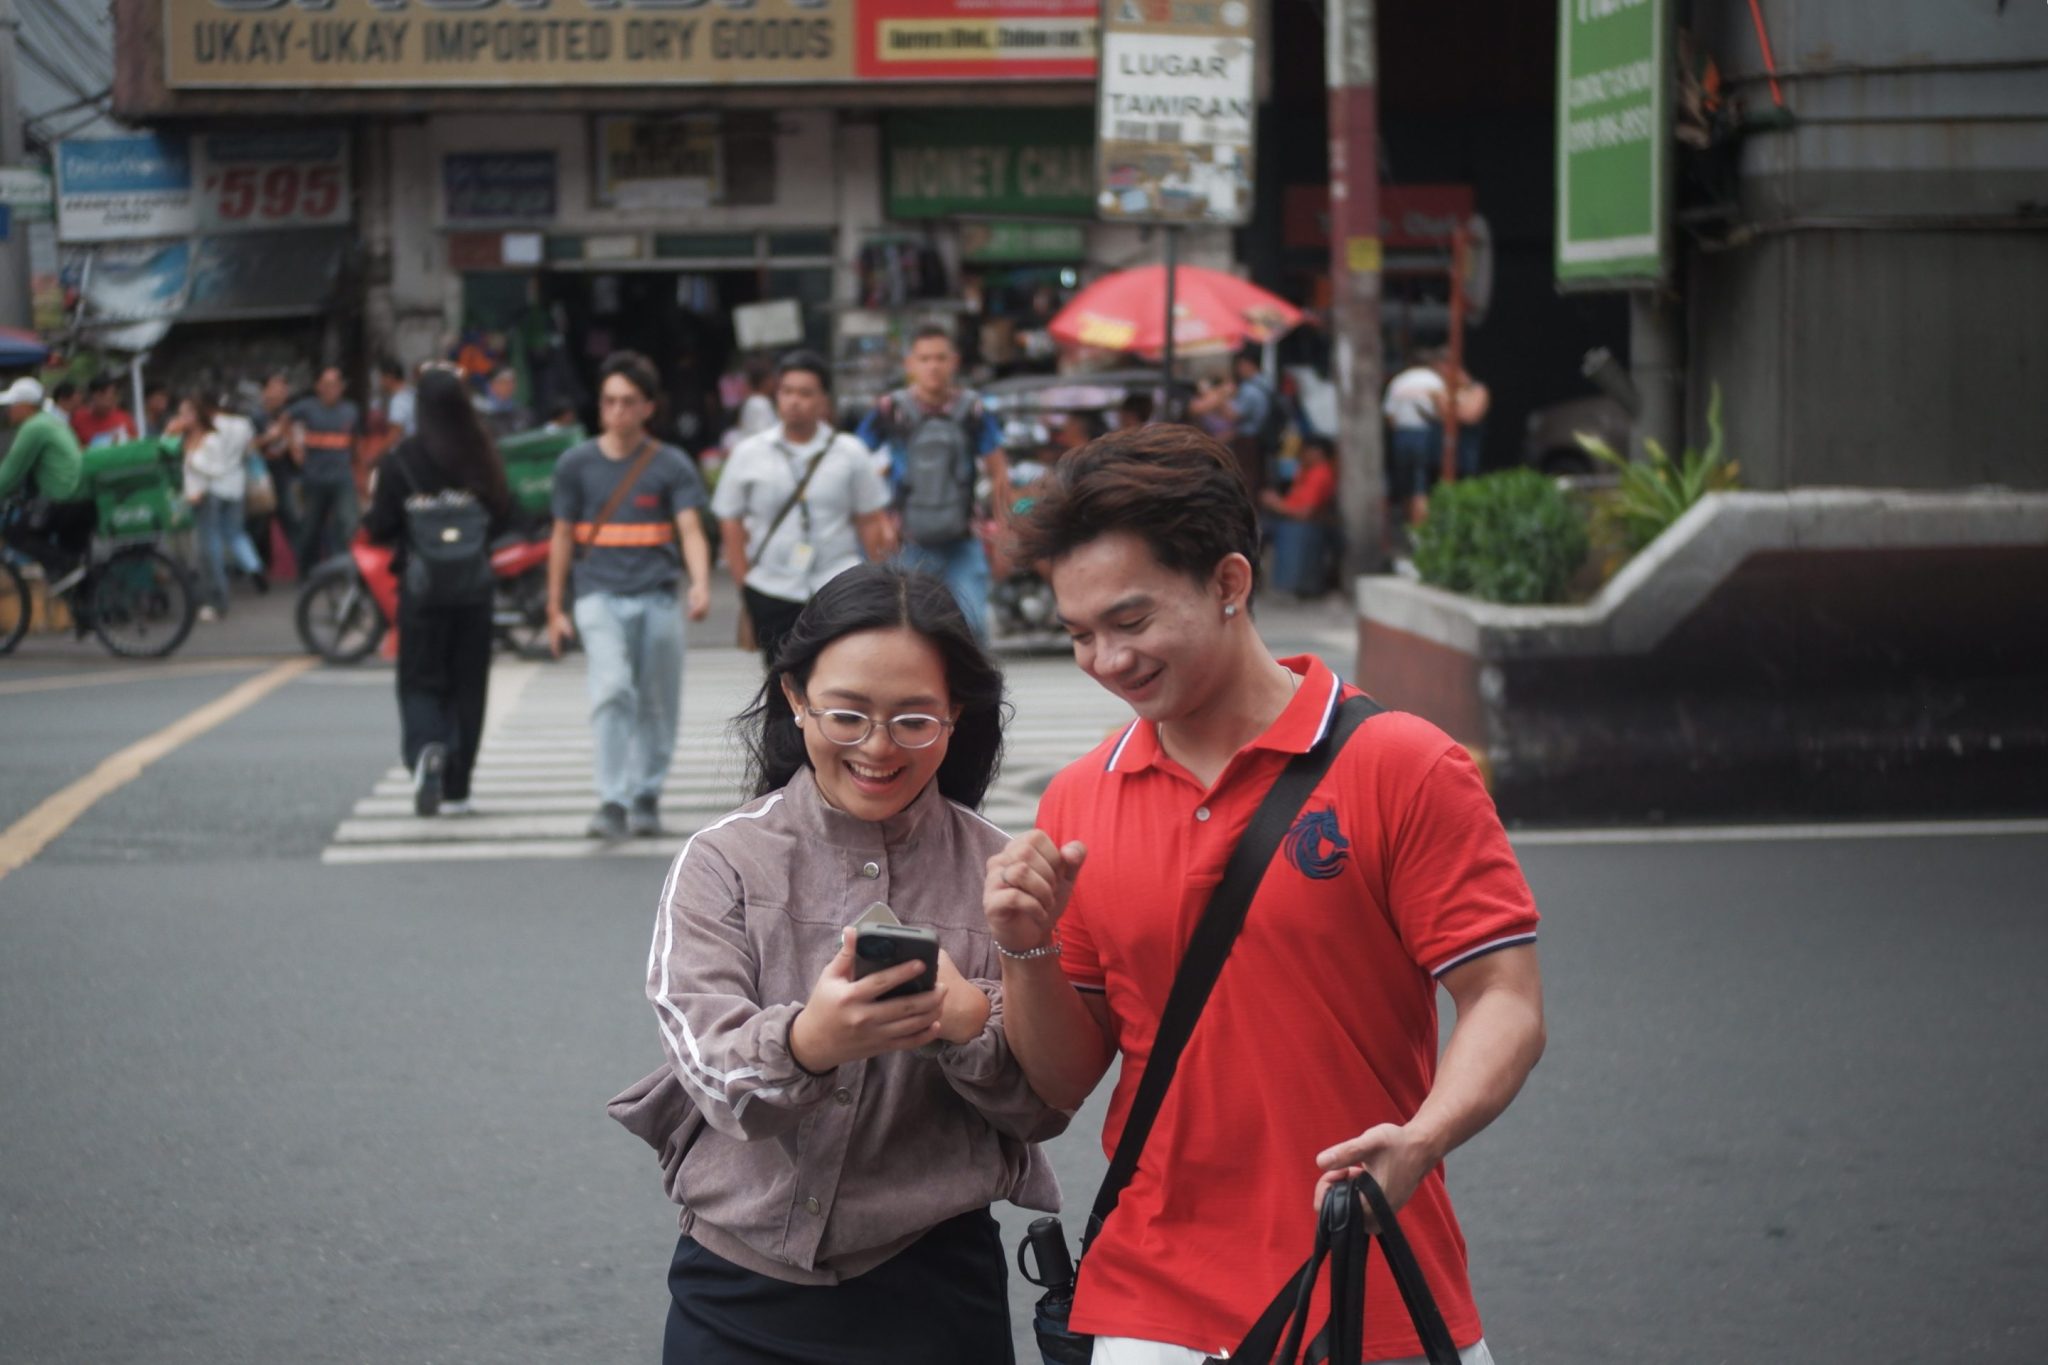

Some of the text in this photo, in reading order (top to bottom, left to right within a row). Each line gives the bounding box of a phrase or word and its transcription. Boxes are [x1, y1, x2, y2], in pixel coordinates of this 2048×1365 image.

[193, 17, 834, 64] UKAY-UKAY IMPORTED DRY GOODS
[1119, 51, 1229, 79] LUGAR
[1105, 92, 1252, 120] TAWIRAN
